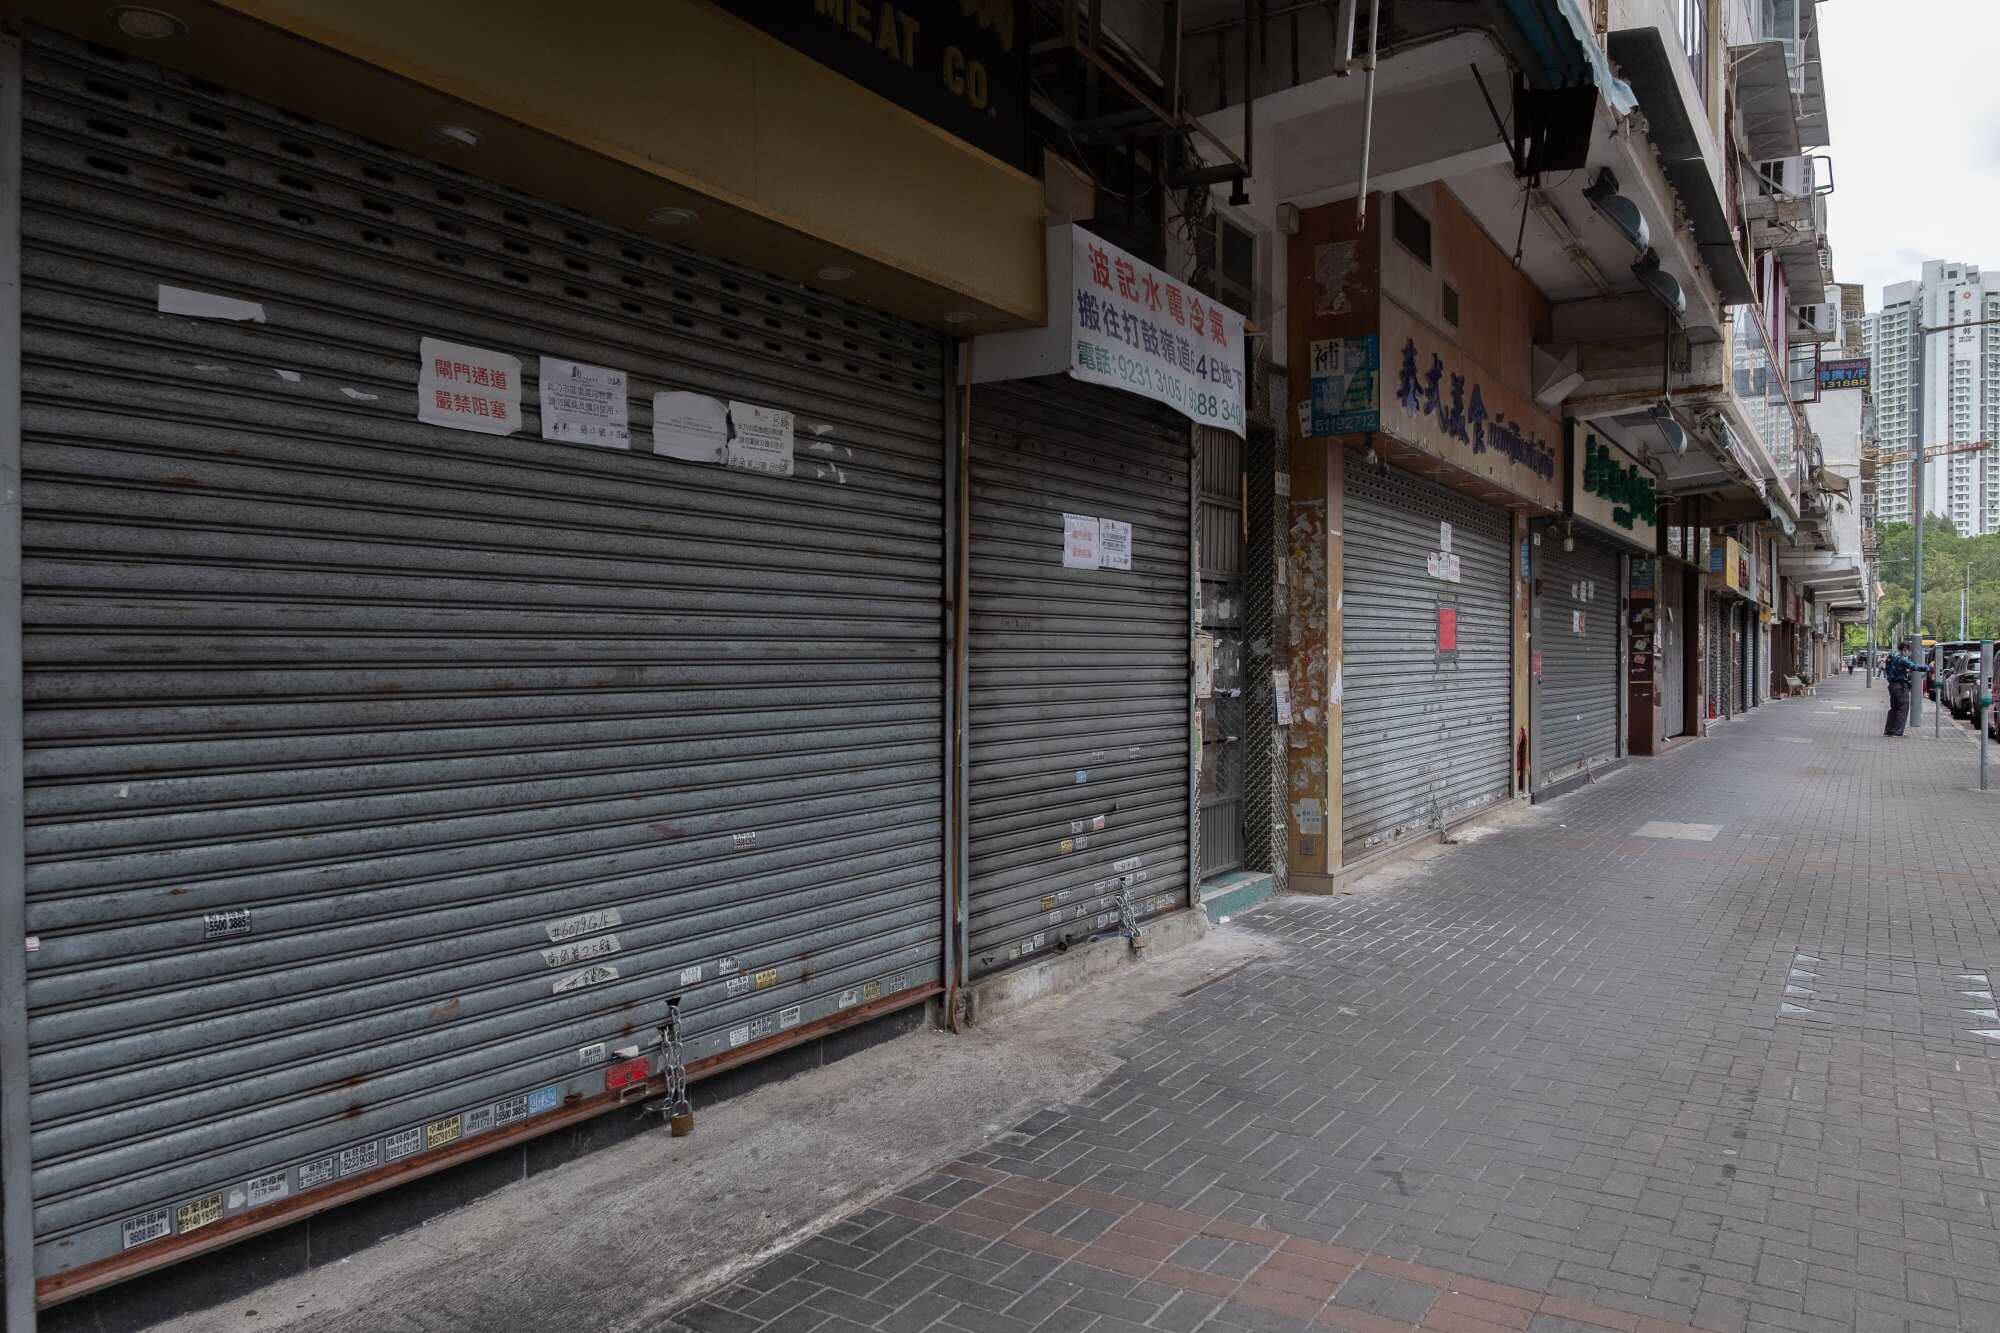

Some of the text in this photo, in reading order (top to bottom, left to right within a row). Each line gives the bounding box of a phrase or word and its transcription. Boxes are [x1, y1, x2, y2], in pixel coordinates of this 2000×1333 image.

[1088, 242, 1227, 348] 波記水電冷氣
[435, 358, 507, 391] 閘門通道
[435, 390, 507, 420] 嚴禁阻塞
